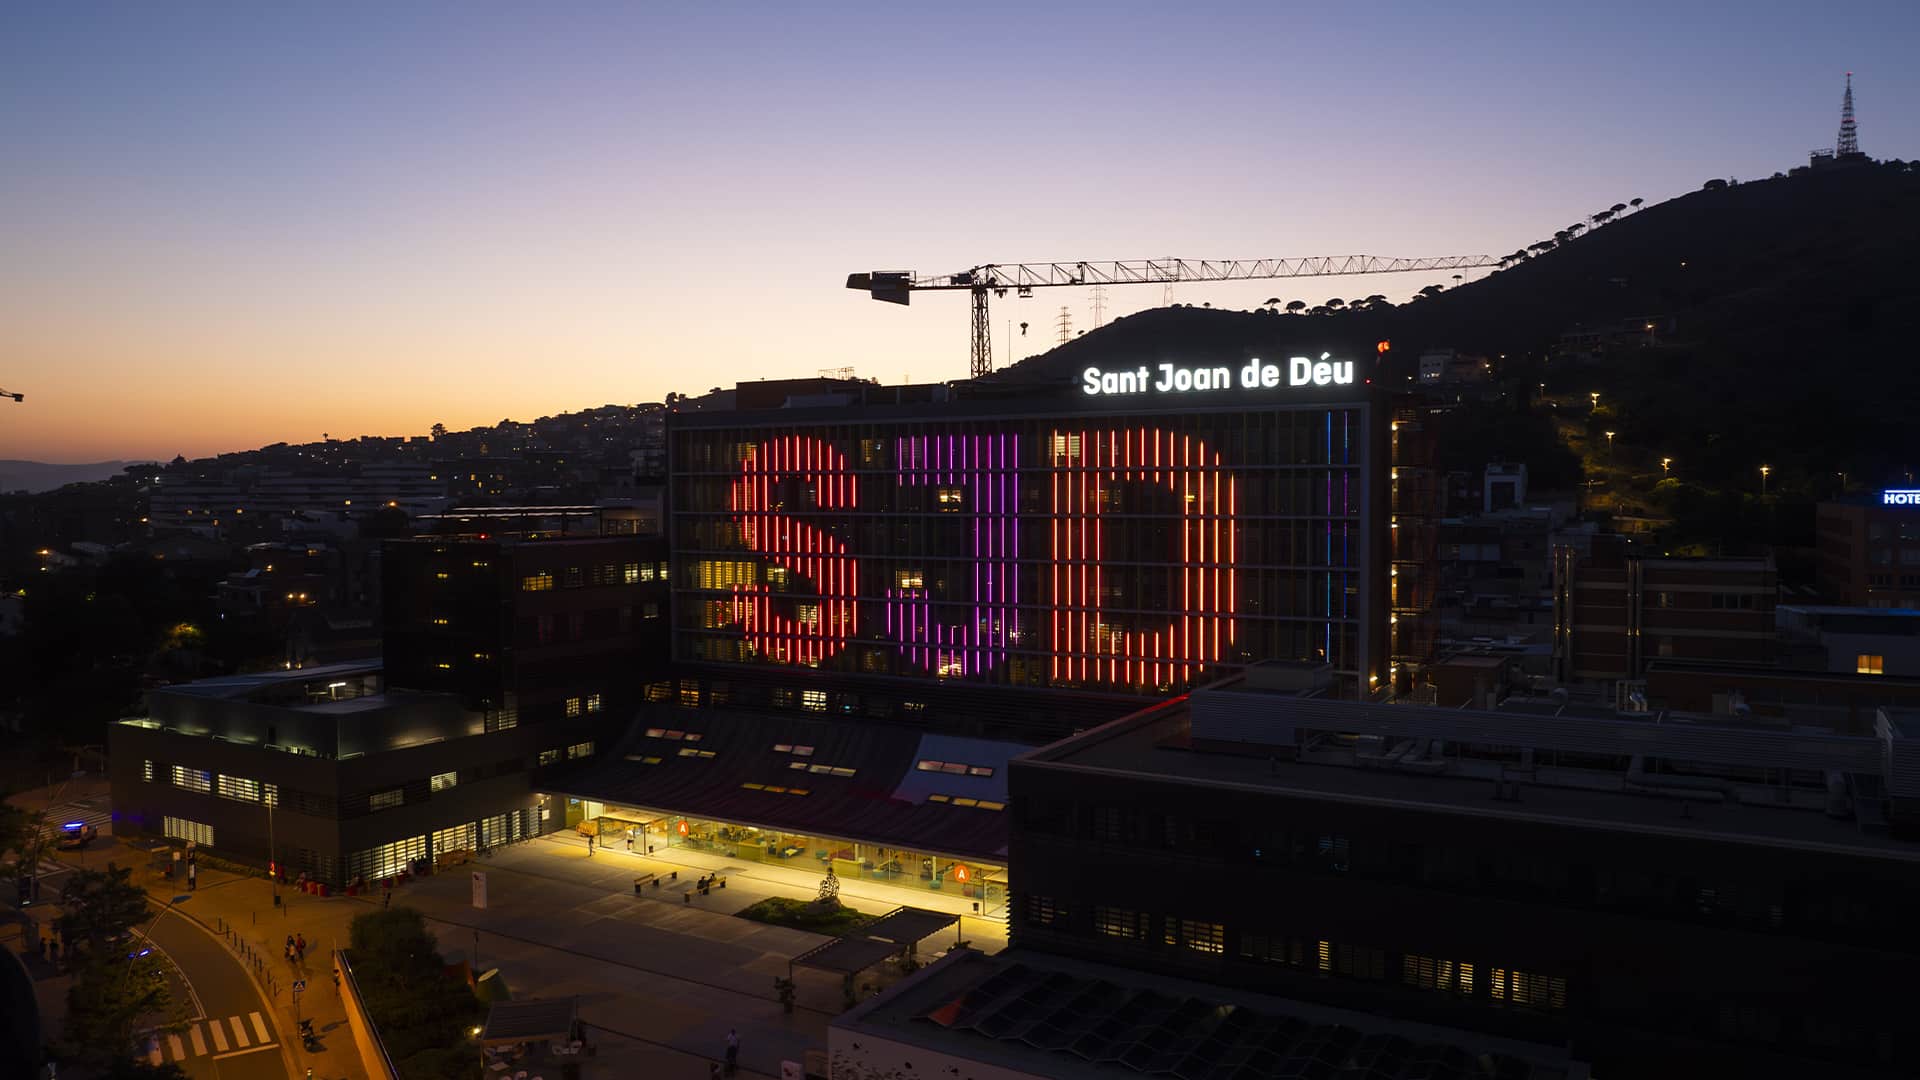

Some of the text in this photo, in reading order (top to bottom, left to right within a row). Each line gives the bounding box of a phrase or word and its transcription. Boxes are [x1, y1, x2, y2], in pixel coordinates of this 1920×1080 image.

[1083, 351, 1353, 395] Sant Joan de Déu
[732, 427, 1237, 686] SJD
